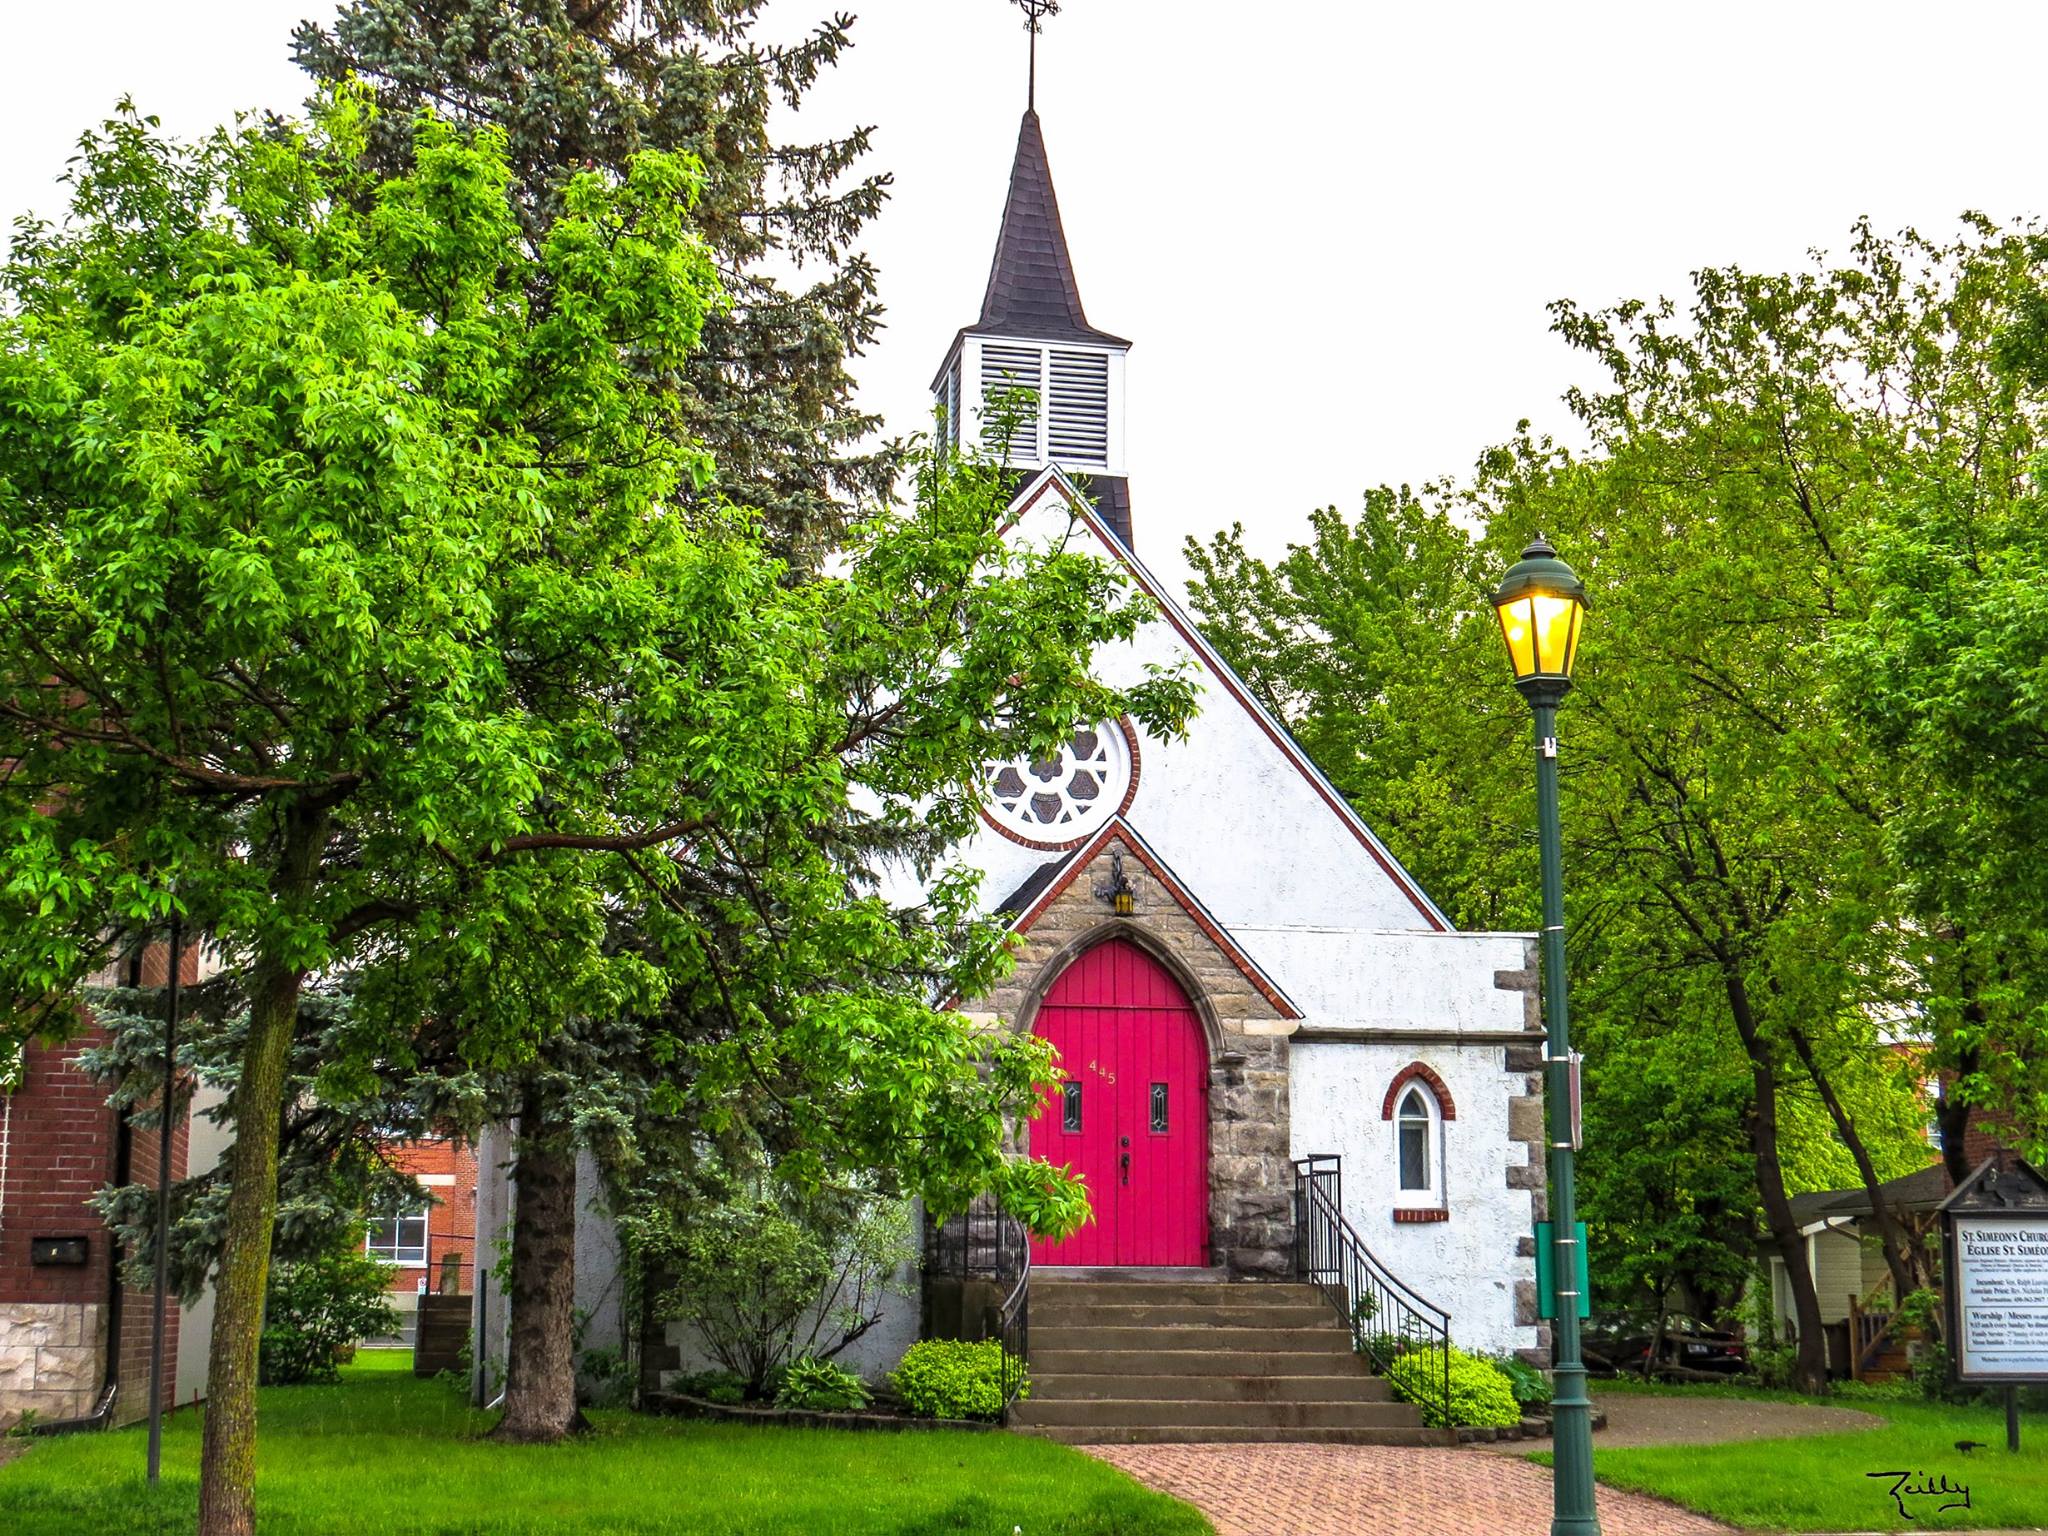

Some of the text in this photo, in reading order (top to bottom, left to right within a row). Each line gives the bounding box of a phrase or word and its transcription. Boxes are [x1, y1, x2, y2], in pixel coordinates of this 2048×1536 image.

[1089, 1060, 1116, 1085] 445
[2017, 1243, 2048, 1256] SIMÉO
[1972, 1311, 2003, 1321] Worship
